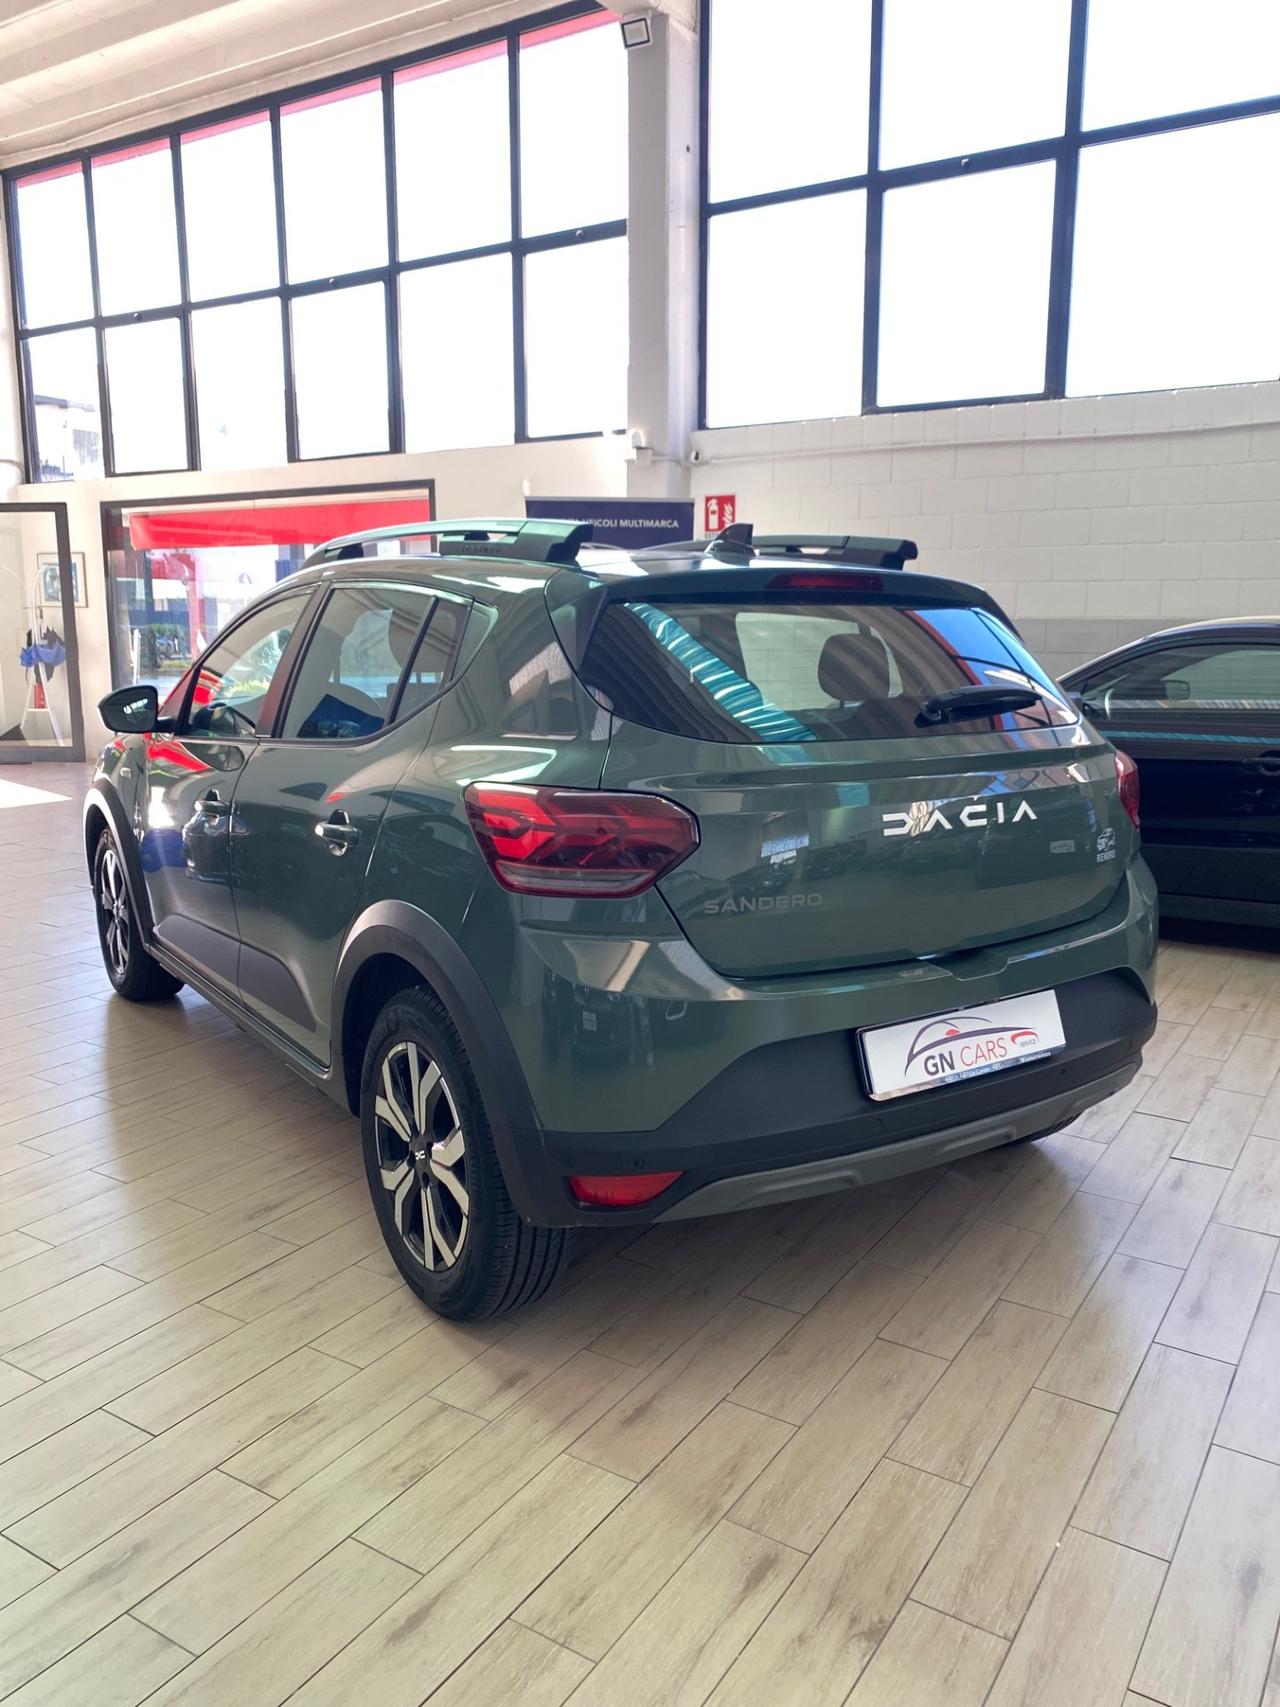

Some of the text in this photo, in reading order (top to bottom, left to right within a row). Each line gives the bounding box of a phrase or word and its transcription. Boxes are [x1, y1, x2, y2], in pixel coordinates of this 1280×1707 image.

[619, 518, 680, 529] MULTIMARCA
[882, 800, 1037, 837] DACIA
[704, 893, 823, 914] SANDERO
[924, 1051, 955, 1076] GN
[960, 1037, 1008, 1067] CARS
